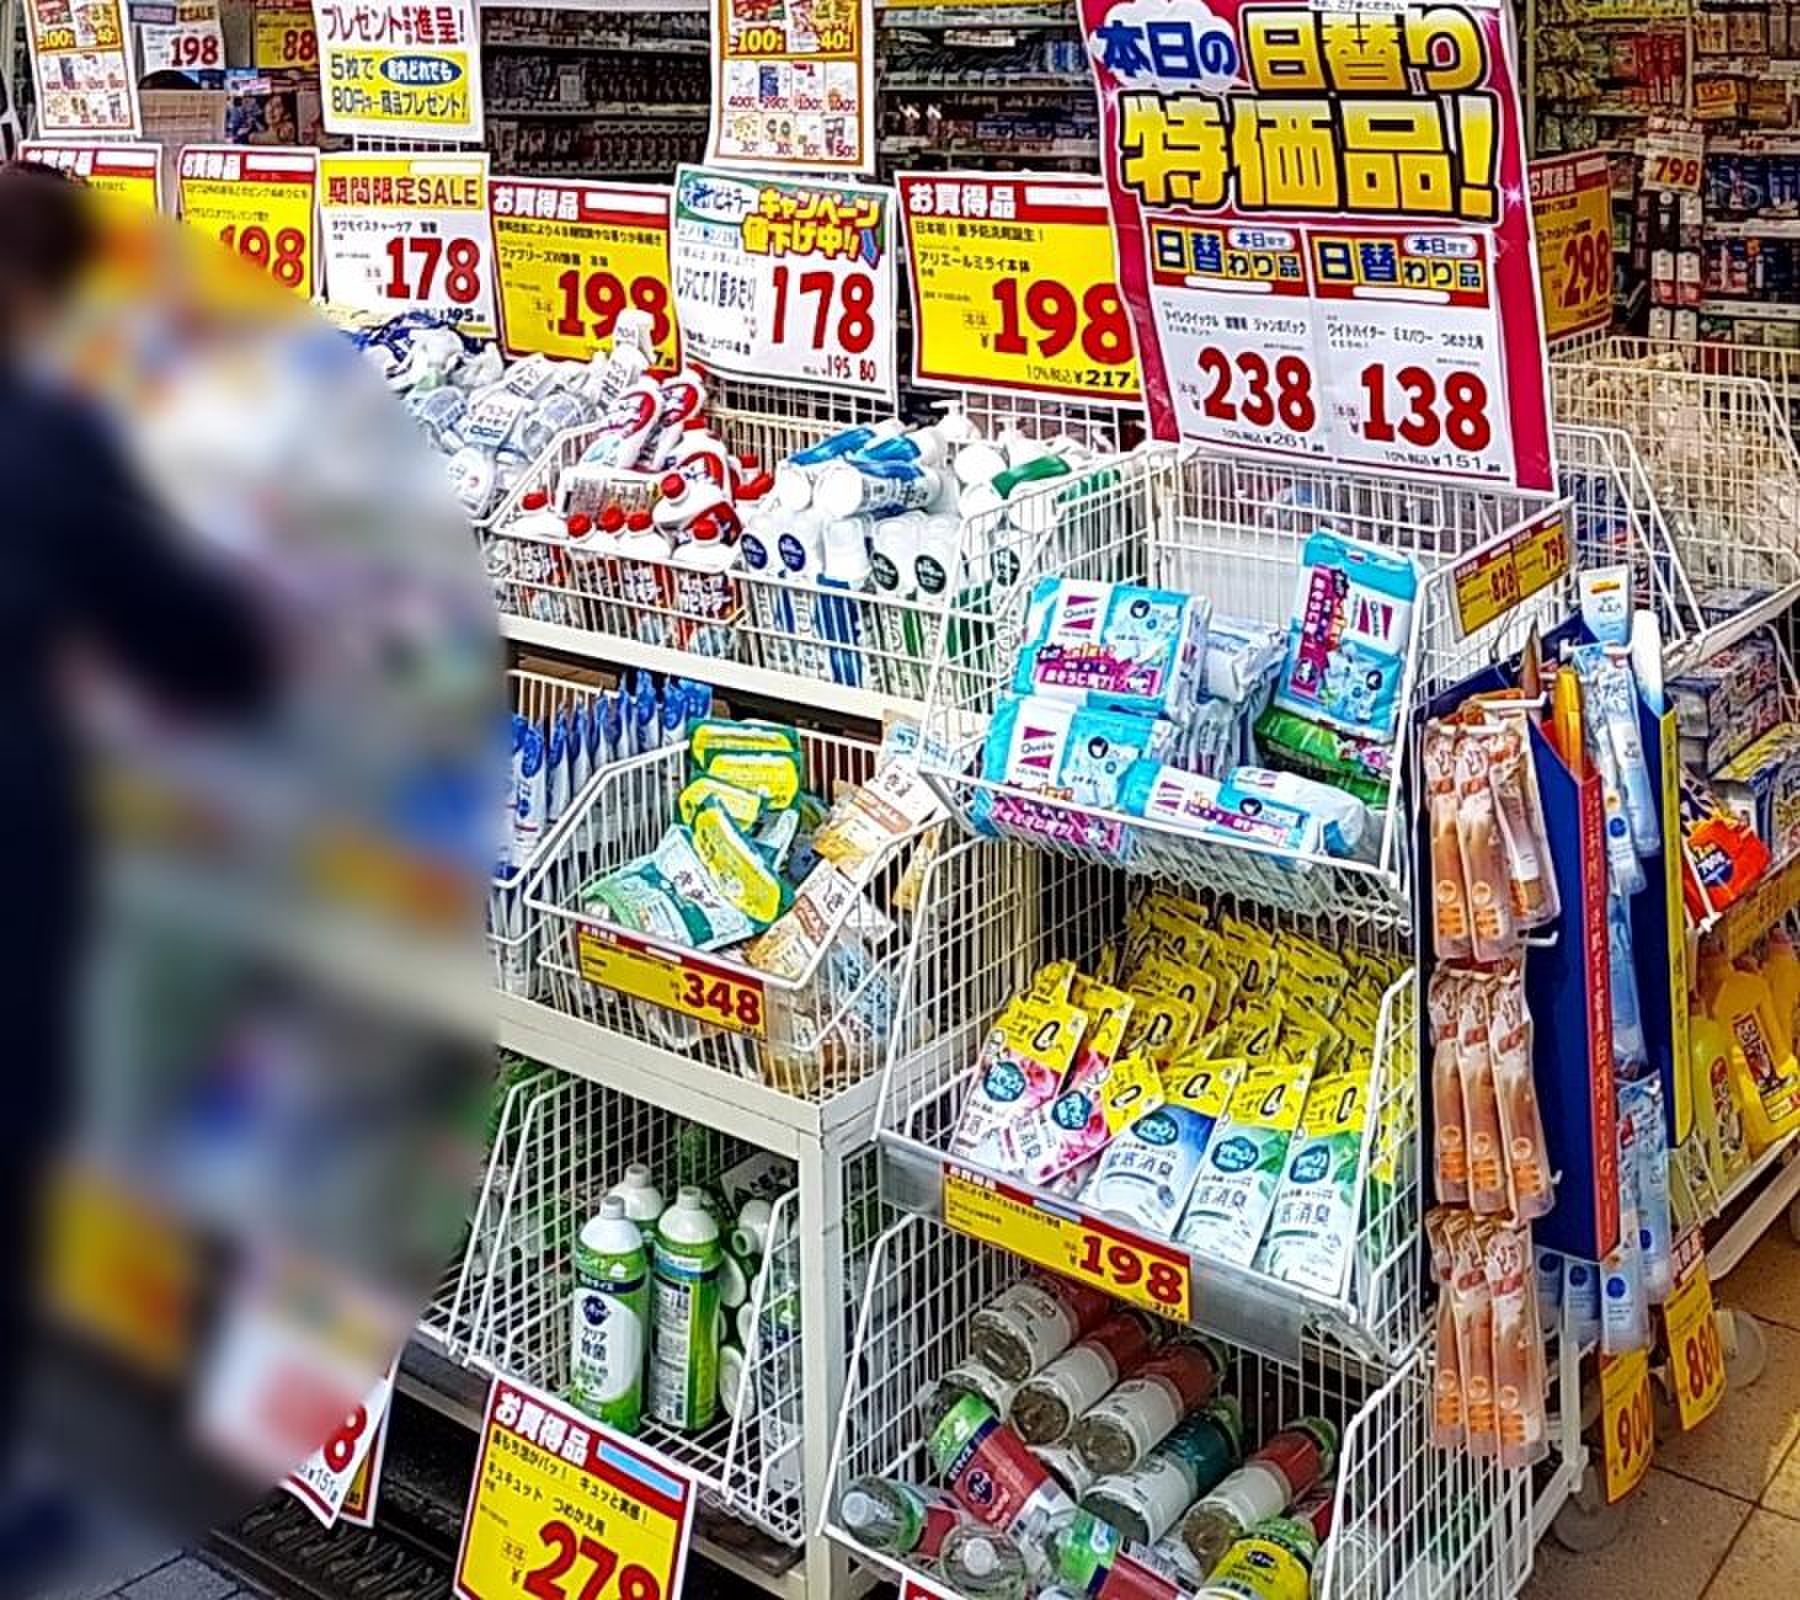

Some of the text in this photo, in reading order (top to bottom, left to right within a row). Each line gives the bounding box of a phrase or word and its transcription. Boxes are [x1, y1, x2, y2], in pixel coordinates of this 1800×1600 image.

[171, 36, 220, 67] 198
[1095, 18, 1238, 79] 本日の
[1244, 5, 1488, 94] 日替り
[328, 176, 478, 206] 期間限定SALE
[1120, 90, 1501, 223] 特価品!
[1654, 156, 1699, 186] 798
[386, 236, 481, 304] 178
[558, 268, 671, 346] 198
[1563, 229, 1610, 307] 298
[772, 265, 875, 354] 178
[992, 276, 1136, 366] 198
[1197, 346, 1316, 433] 238
[1361, 363, 1491, 452] 138
[682, 972, 761, 1026] 348
[1079, 1233, 1184, 1305] 198
